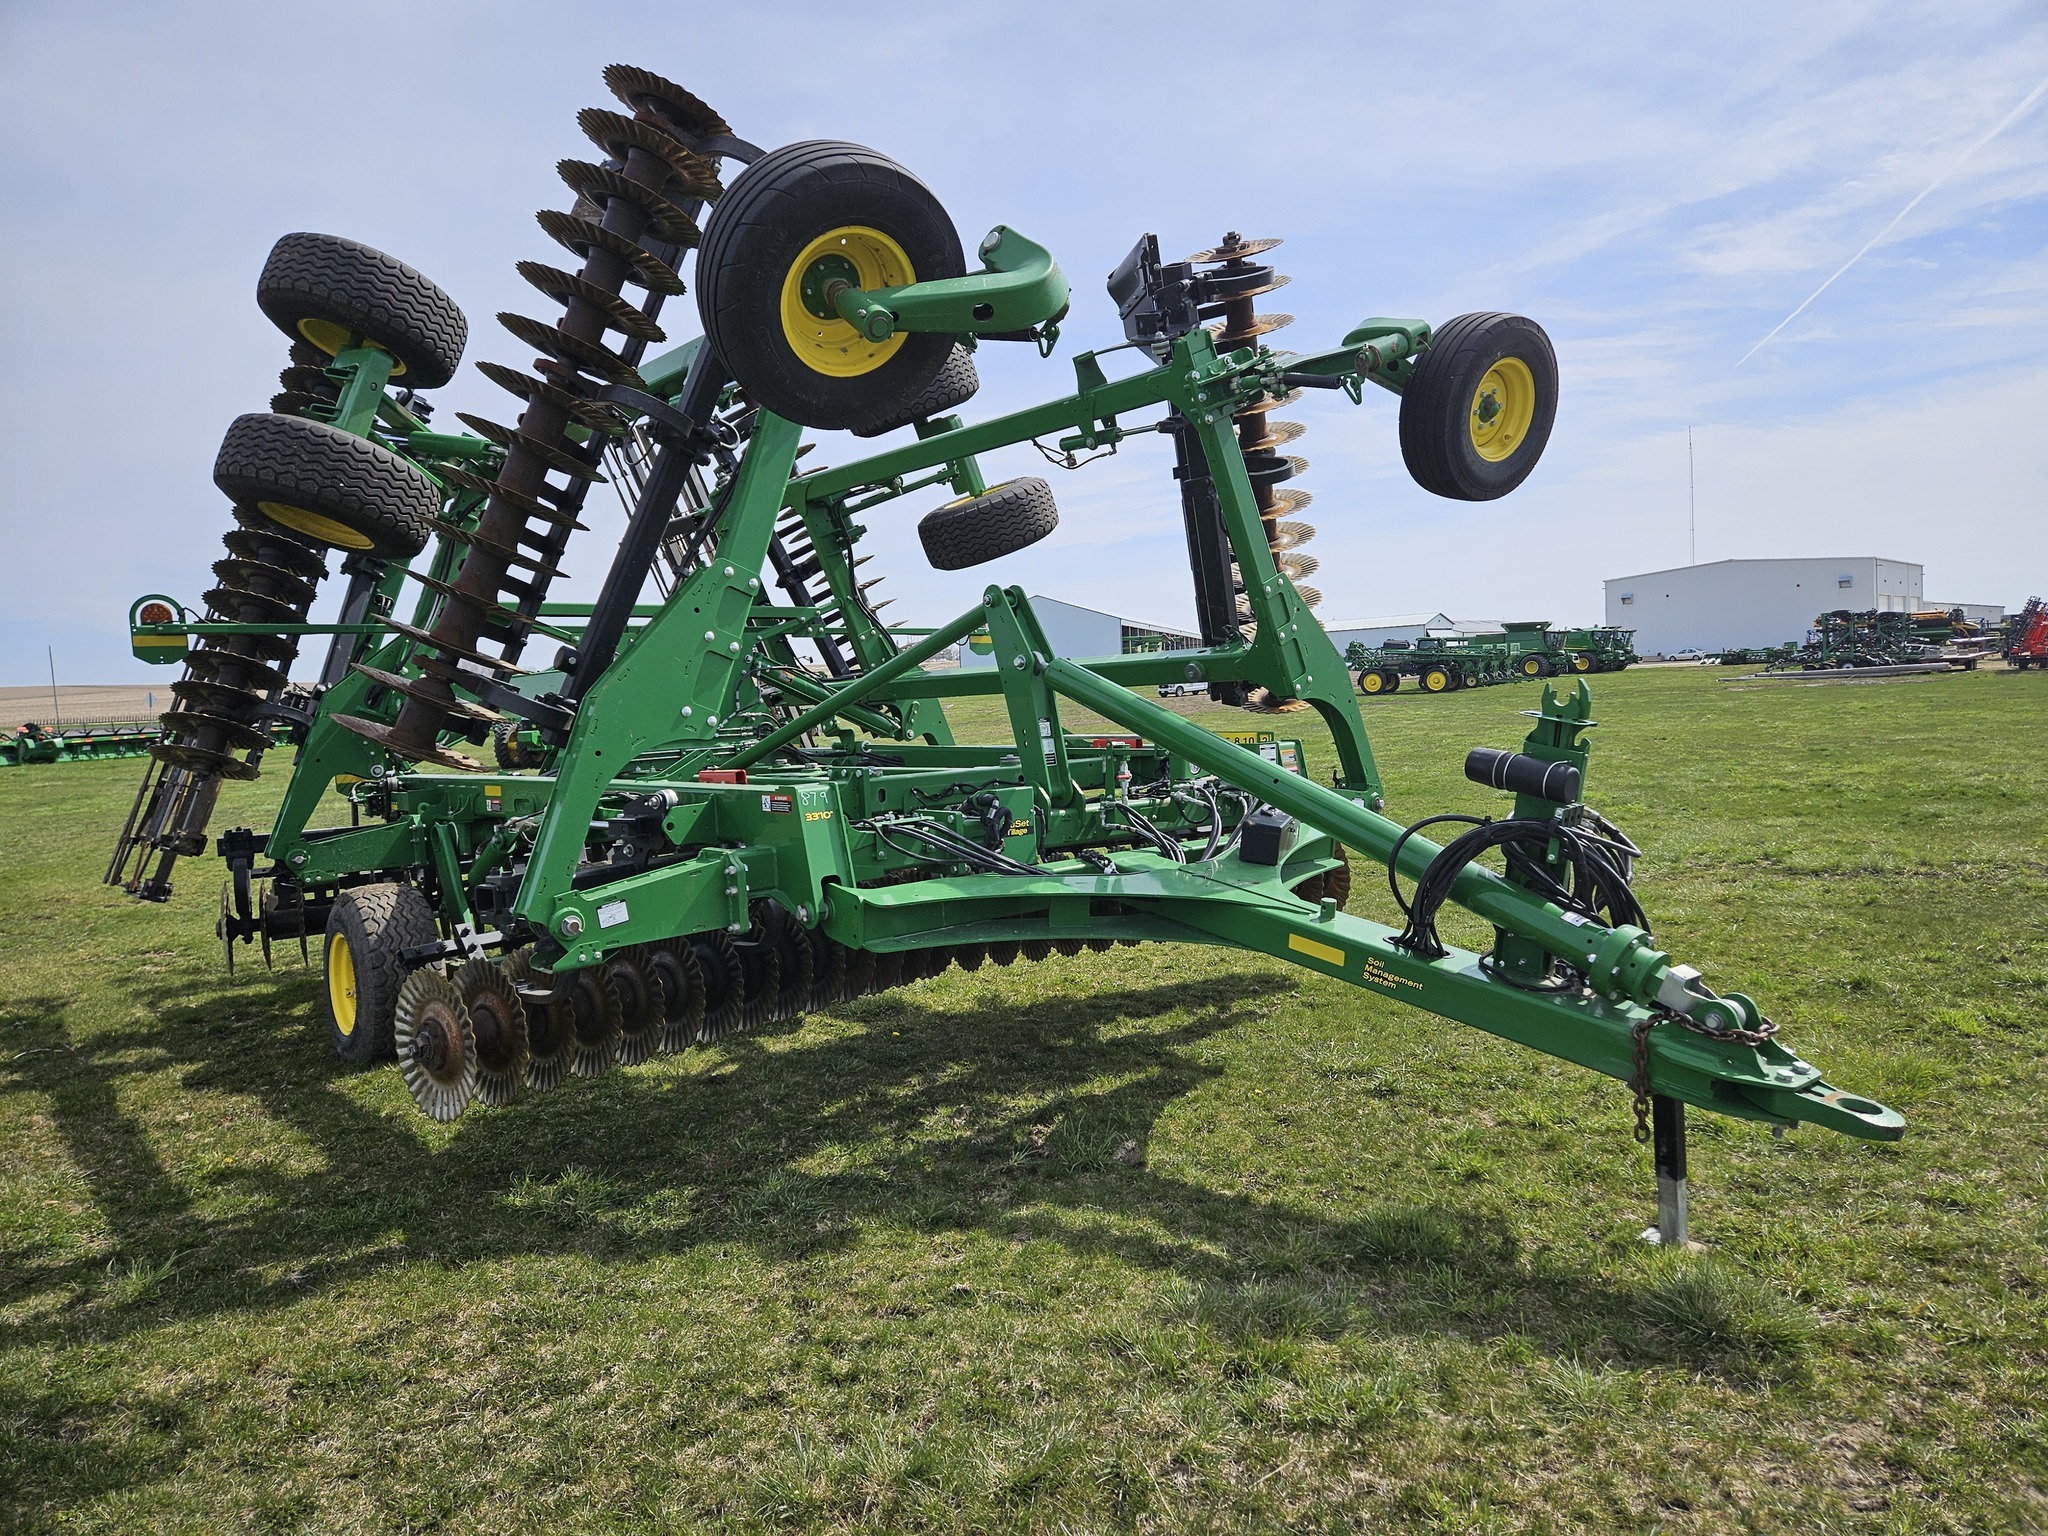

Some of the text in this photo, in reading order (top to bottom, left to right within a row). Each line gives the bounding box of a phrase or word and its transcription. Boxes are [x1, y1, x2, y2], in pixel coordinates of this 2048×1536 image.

[800, 791, 828, 806] 879
[1009, 819, 1030, 828] uSet
[1367, 956, 1385, 968] Soil
[1362, 971, 1397, 990] System
[1364, 964, 1424, 990] Management
